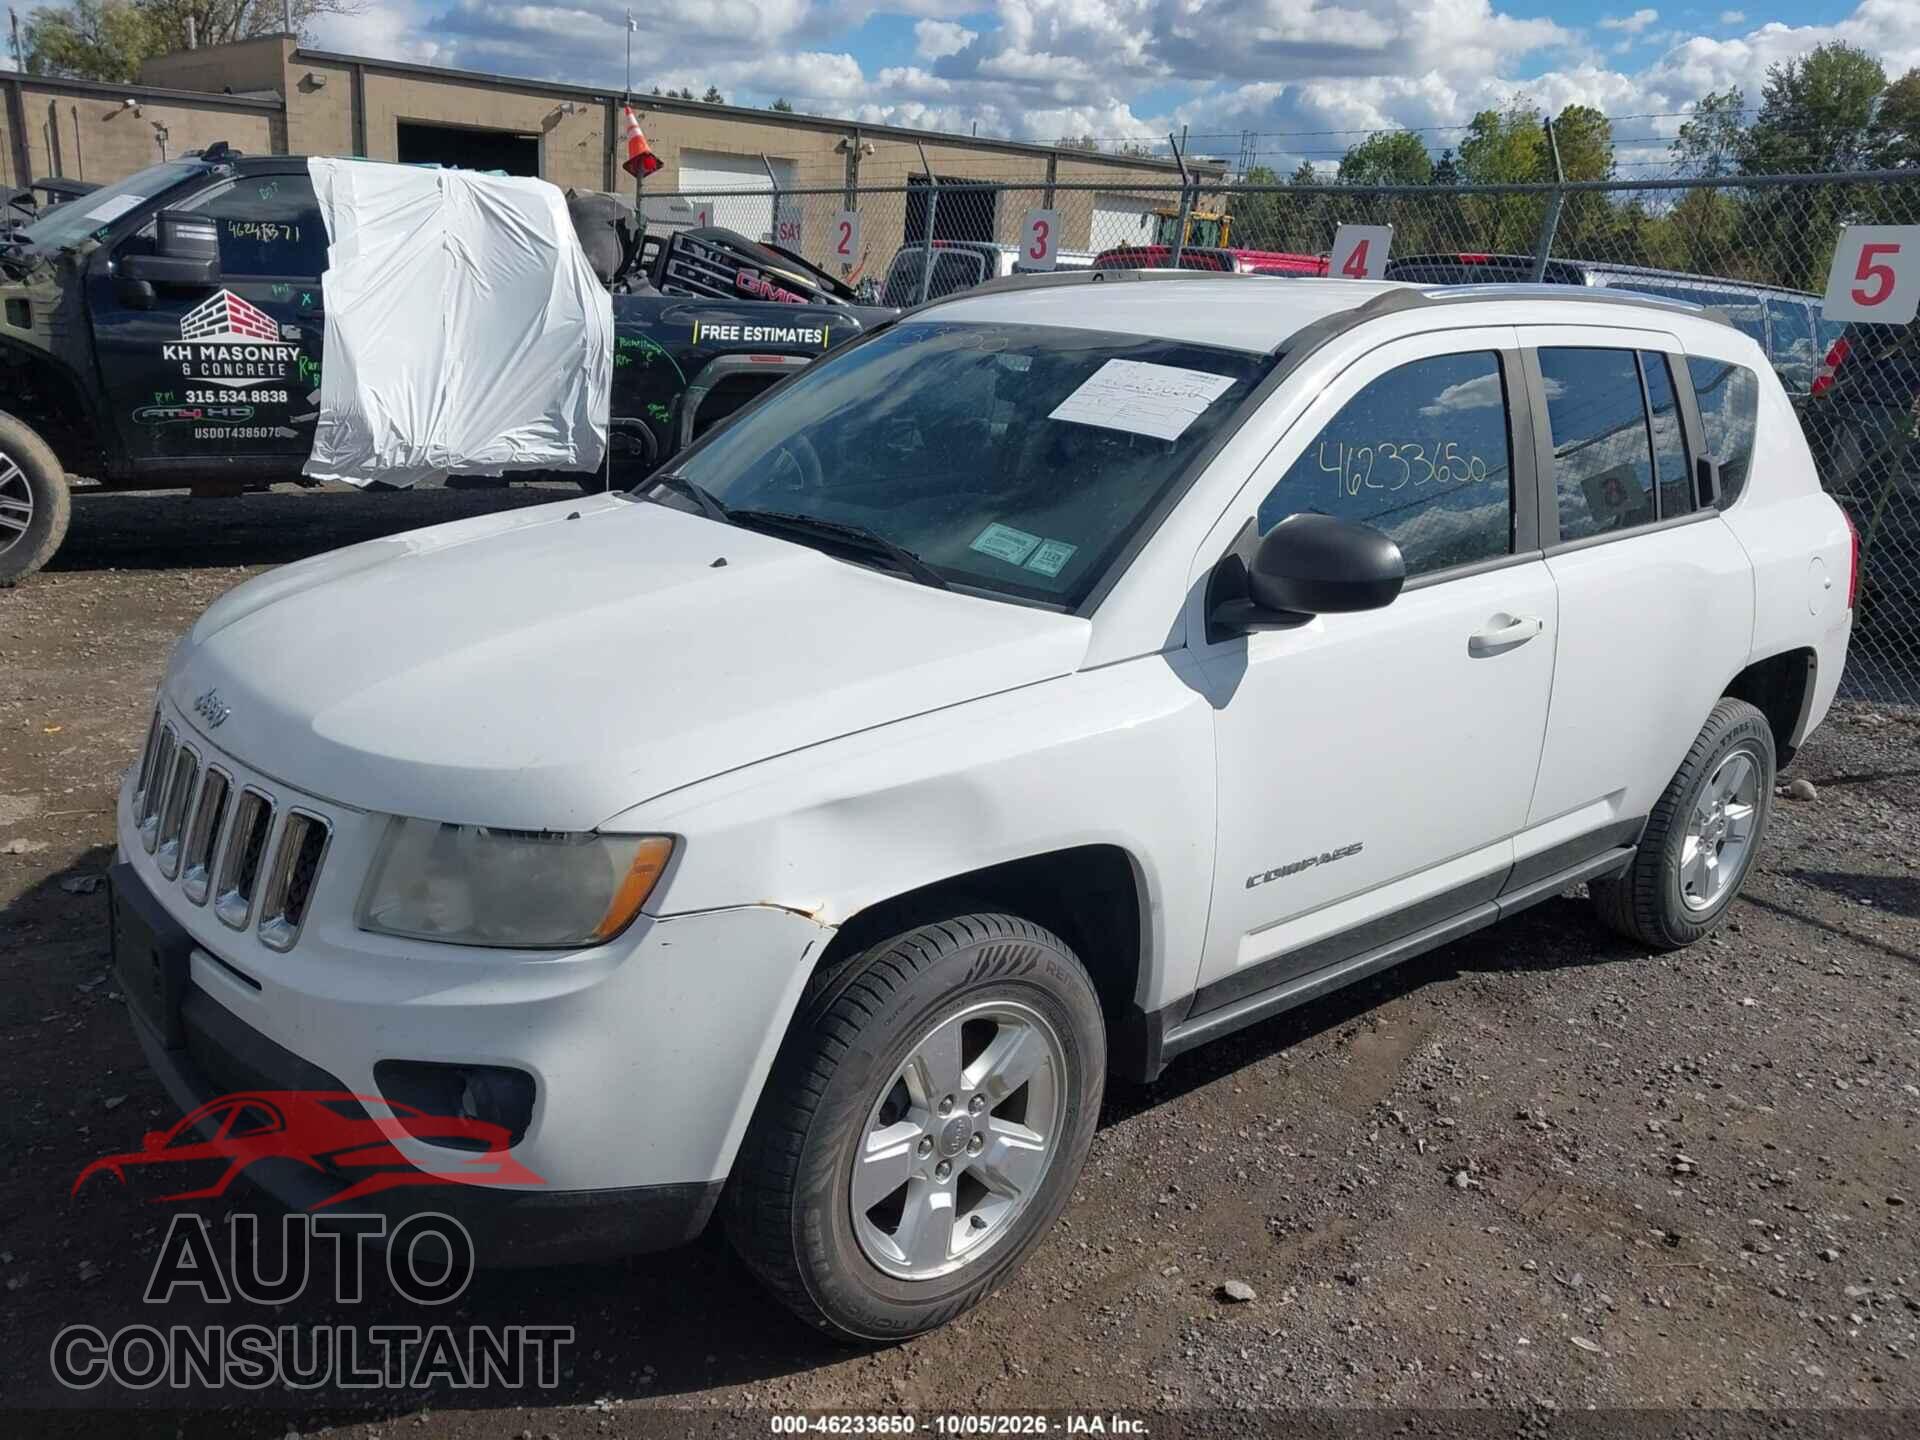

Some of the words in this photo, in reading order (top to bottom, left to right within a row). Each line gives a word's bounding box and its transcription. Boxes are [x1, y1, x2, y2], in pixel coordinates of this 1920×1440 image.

[698, 211, 706, 228] 1
[838, 221, 852, 254] 2
[1029, 220, 1049, 259] 3
[1343, 239, 1370, 278] 4
[1851, 243, 1902, 307] 5
[700, 325, 739, 341] FREE
[743, 327, 823, 344] ESTIMATES
[162, 345, 193, 361] KH
[200, 346, 300, 362] MASONRY
[182, 362, 191, 376] &
[201, 362, 286, 377] CONCRETE
[185, 389, 288, 404] 315.534.8838
[207, 408, 251, 417] HD
[1318, 441, 1487, 498] 46233650
[1245, 841, 1364, 889] COMPASS
